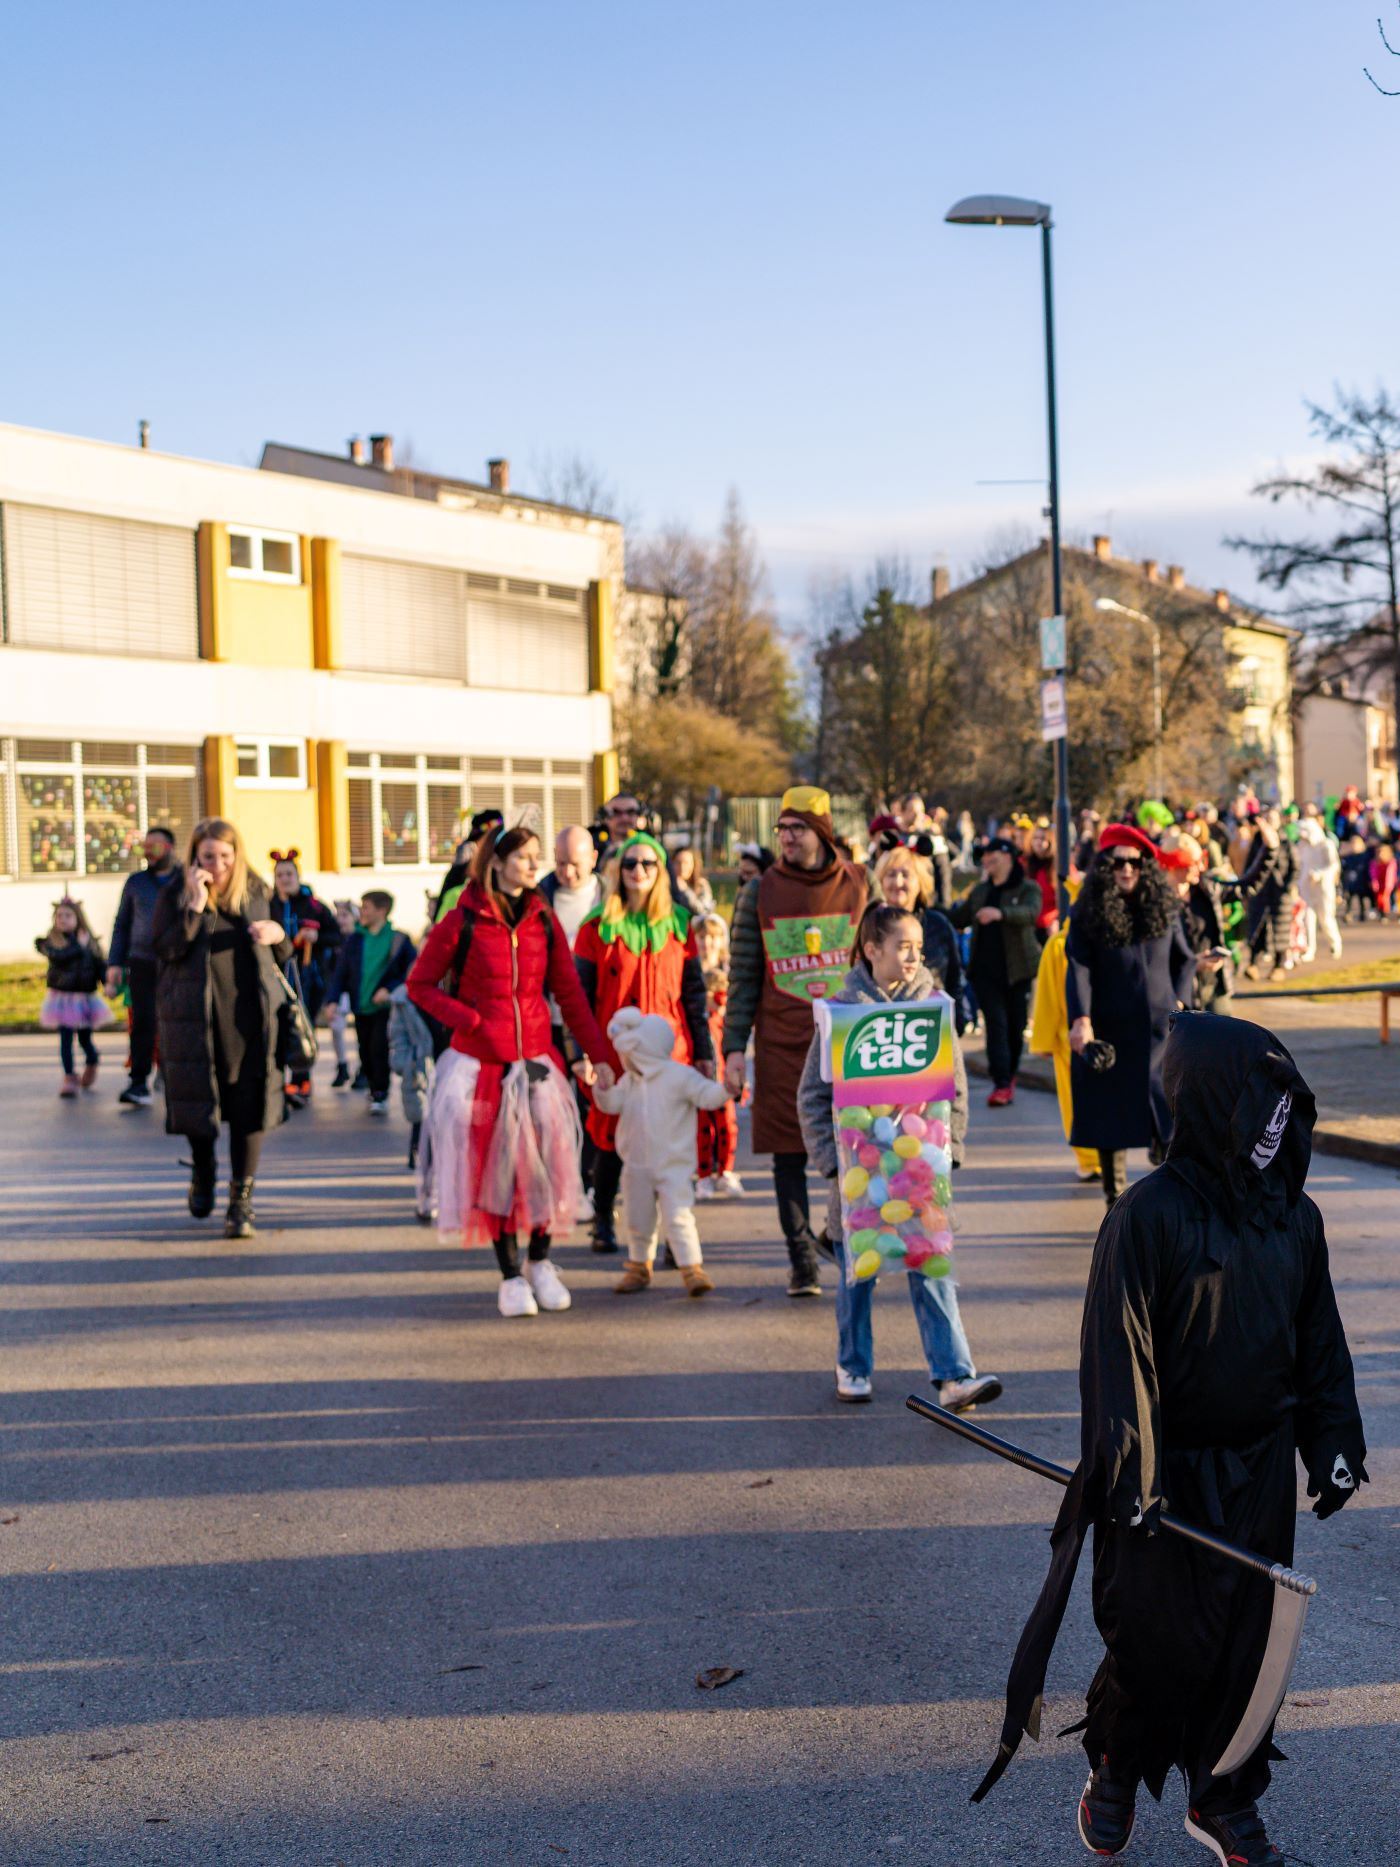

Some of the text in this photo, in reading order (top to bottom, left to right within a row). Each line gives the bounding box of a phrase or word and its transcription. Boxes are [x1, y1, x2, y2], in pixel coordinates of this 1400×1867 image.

[772, 955, 820, 974] ULTRA
[872, 1012, 928, 1045] tic
[858, 1041, 927, 1070] tac
